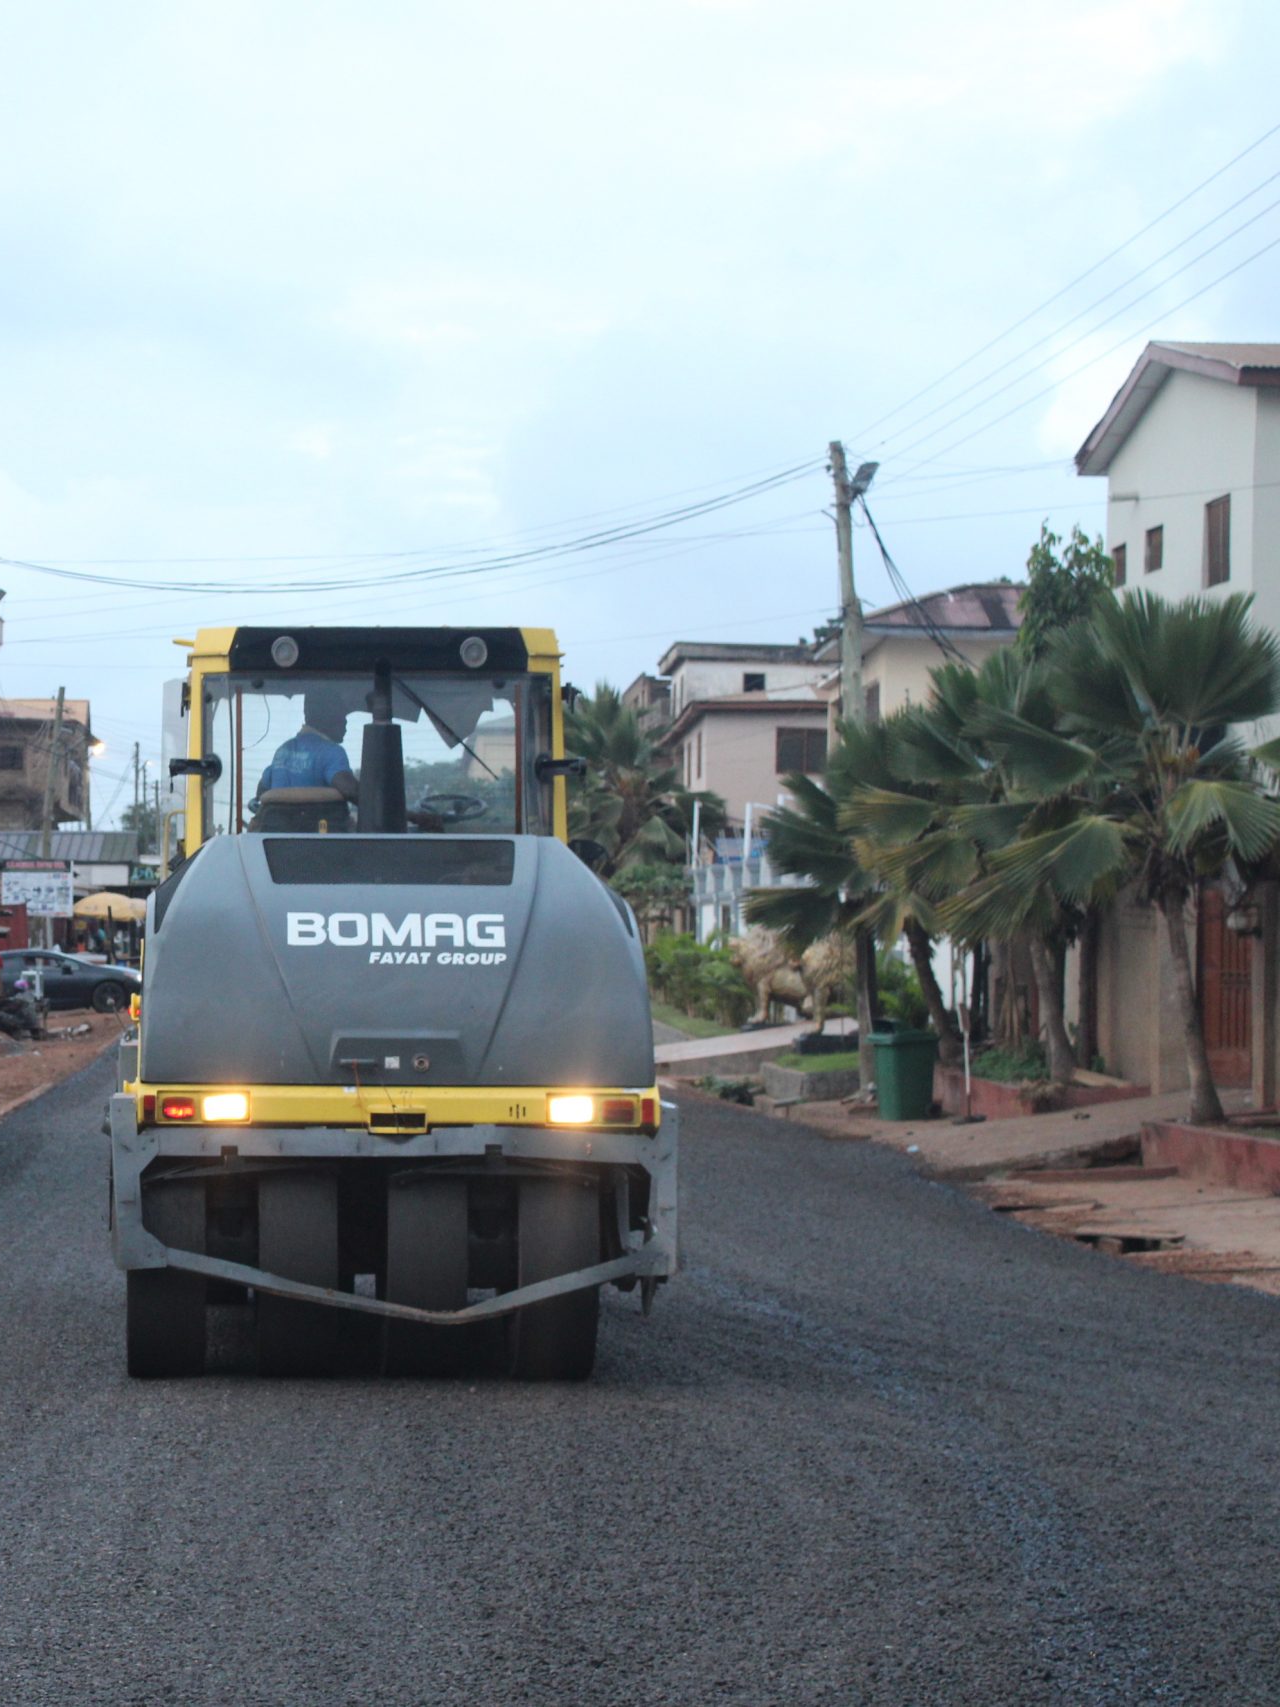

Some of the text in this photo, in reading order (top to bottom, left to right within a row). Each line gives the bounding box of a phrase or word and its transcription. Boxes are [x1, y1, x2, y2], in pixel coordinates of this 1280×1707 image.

[287, 912, 506, 947] BOMAG
[369, 951, 507, 965] FAYAT GROUP
